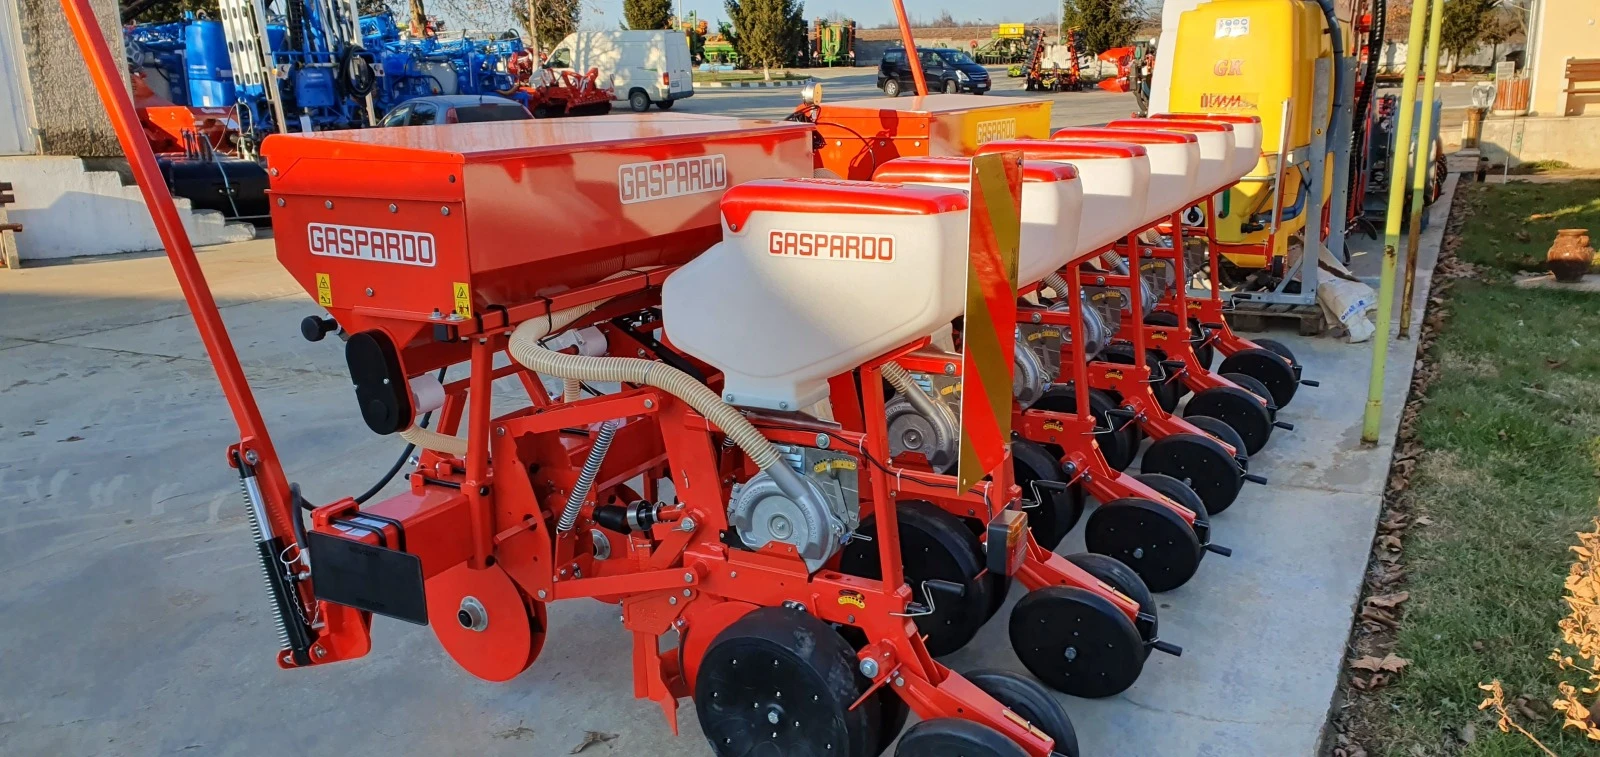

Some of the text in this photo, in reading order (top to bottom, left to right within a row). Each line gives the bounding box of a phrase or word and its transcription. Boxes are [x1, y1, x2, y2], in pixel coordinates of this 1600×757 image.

[1214, 60, 1244, 76] GK
[978, 119, 1015, 144] GASPARDO
[620, 157, 725, 201] GASPARDO
[310, 225, 433, 264] GASPARDO
[769, 231, 893, 261] GASPARDO
